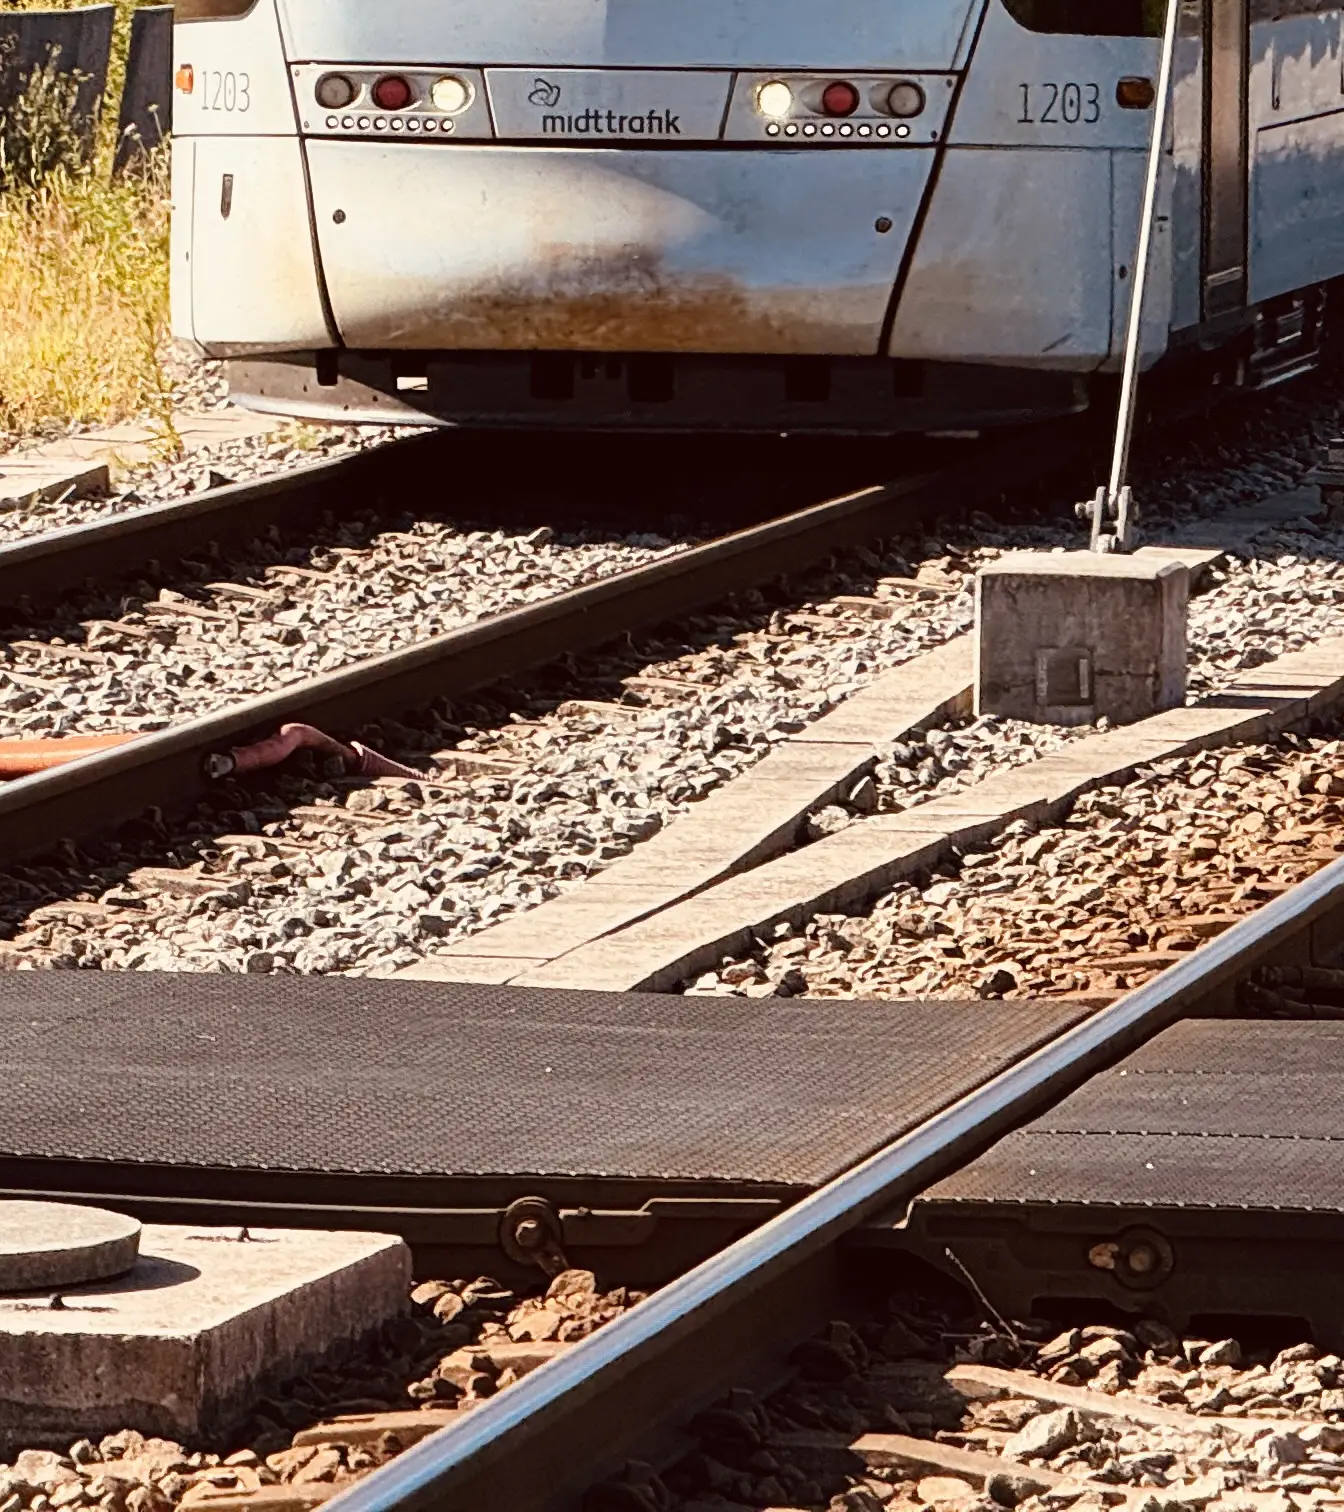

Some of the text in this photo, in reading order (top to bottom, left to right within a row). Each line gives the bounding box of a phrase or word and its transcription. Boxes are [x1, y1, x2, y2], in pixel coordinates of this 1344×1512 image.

[201, 71, 250, 112] 1203
[1017, 82, 1100, 123] 1203
[542, 108, 681, 134] midttrafik
